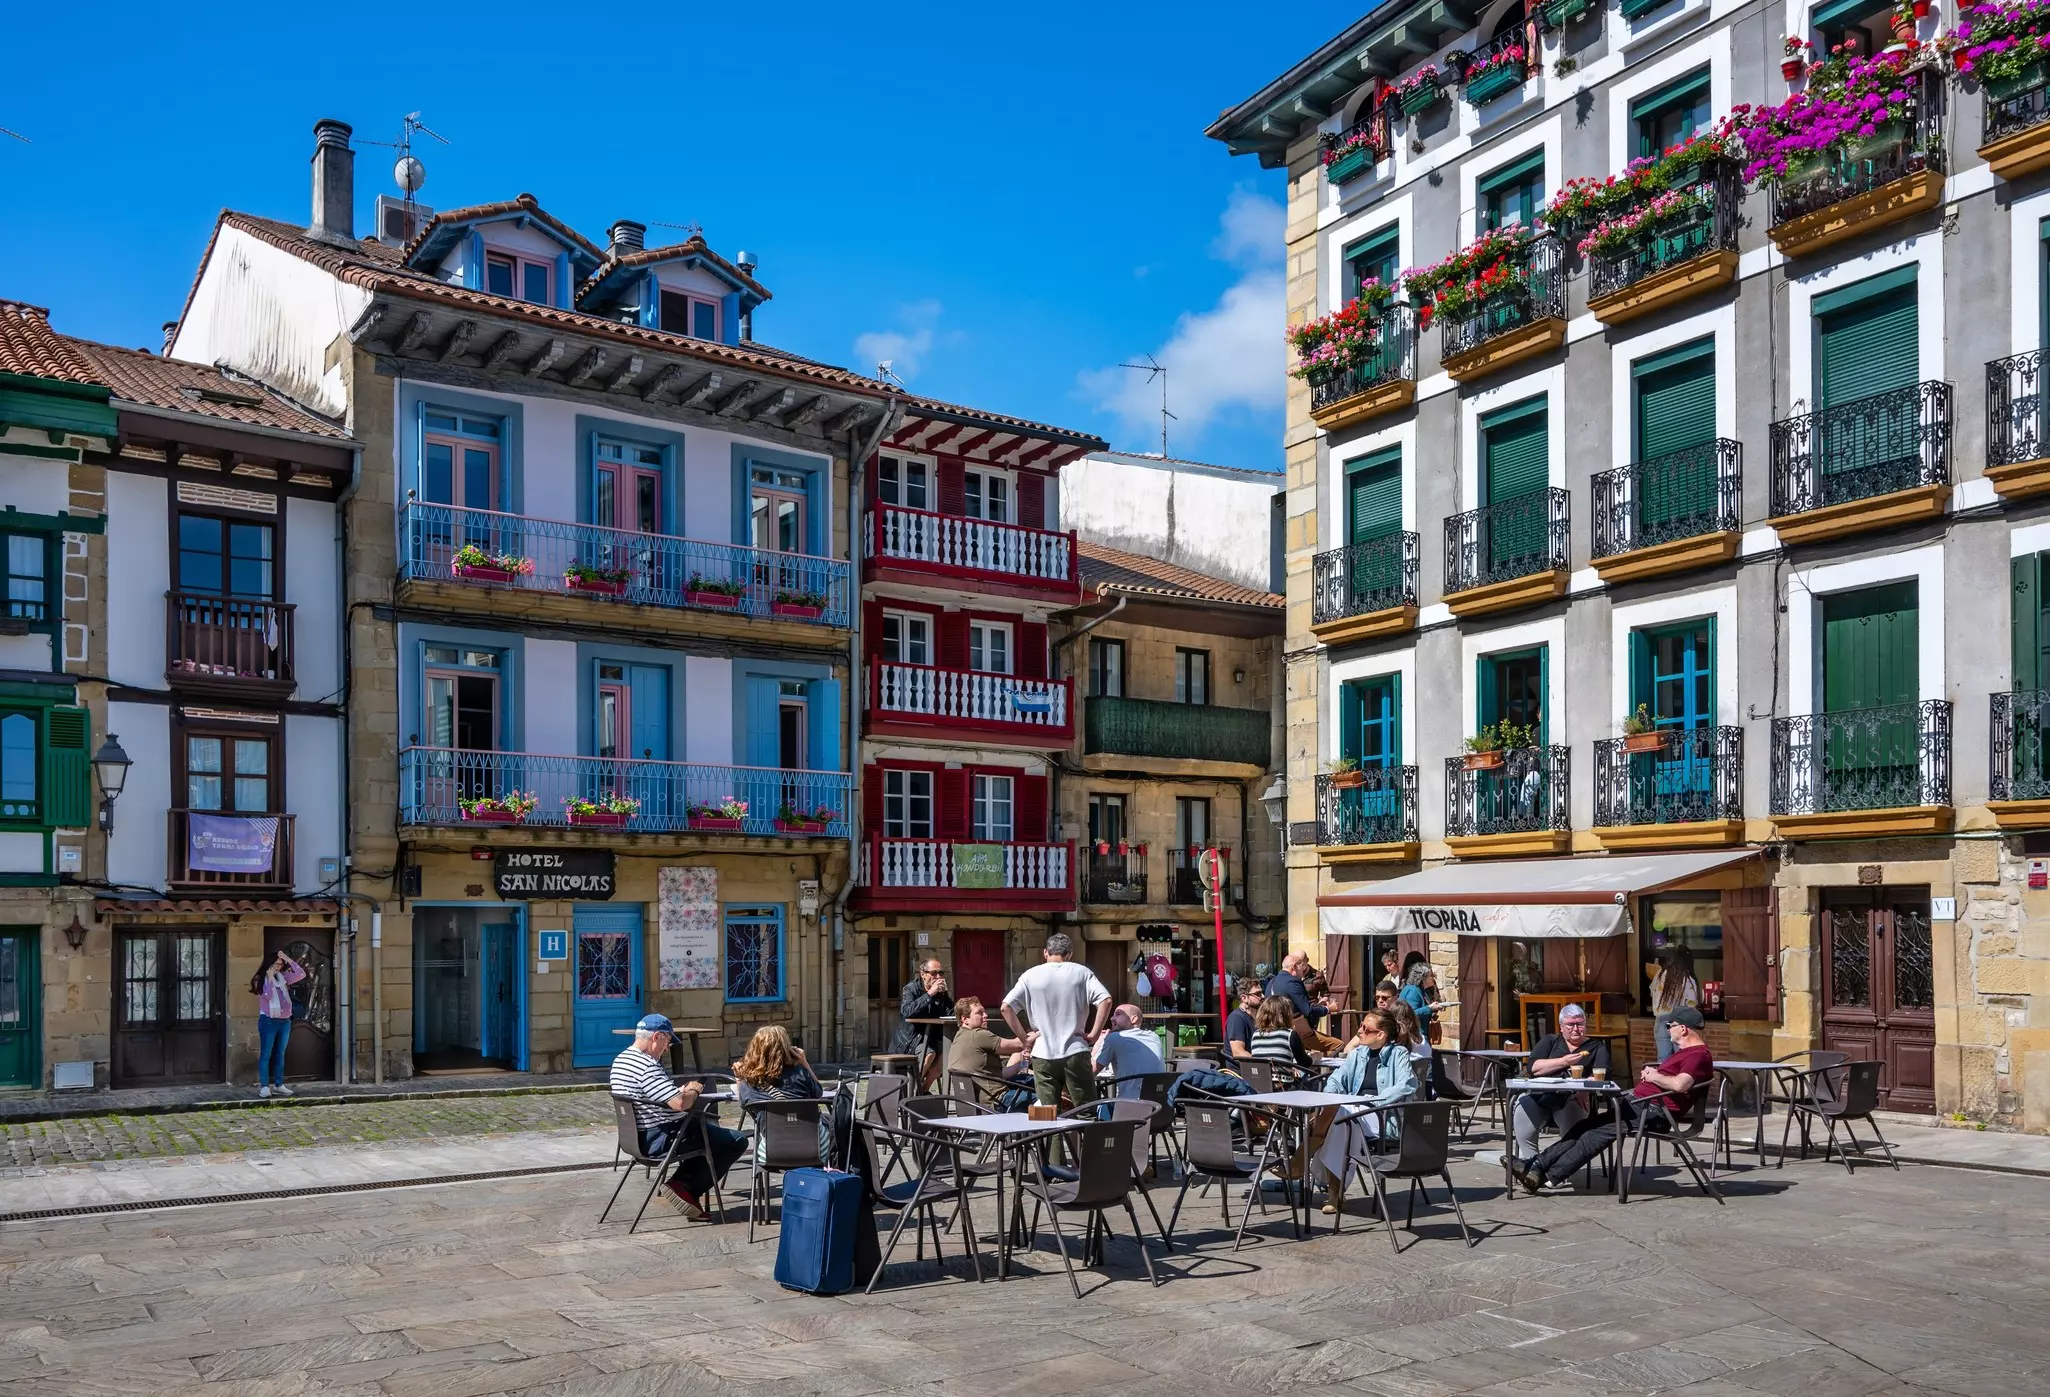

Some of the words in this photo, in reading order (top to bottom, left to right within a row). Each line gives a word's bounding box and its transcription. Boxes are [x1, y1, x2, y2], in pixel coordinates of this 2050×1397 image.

[508, 853, 564, 867] HOTEL
[500, 874, 538, 891] SAN
[1934, 900, 1954, 912] VT
[1409, 909, 1482, 932] TTOPARA
[547, 936, 560, 951] H
